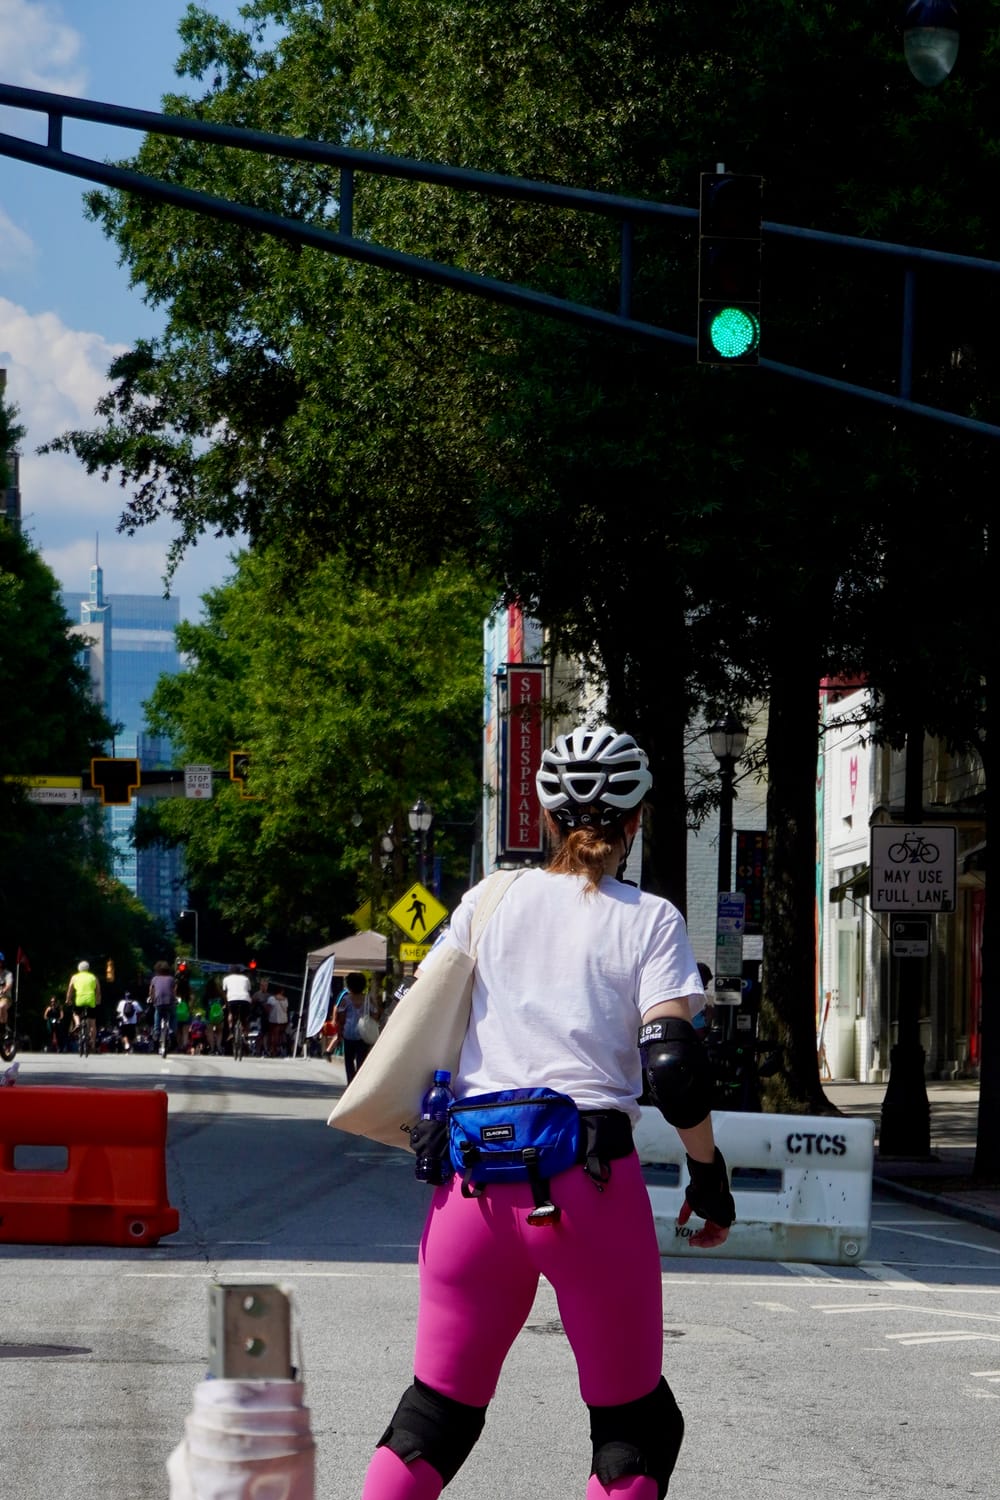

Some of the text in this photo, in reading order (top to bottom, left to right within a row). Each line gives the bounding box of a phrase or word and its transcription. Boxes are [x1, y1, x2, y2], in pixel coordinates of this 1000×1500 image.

[519, 677, 532, 843] SHAKESPEARE
[188, 775, 209, 783] STOP
[884, 869, 943, 884] MAY USE
[877, 889, 949, 903] FULL LANE
[404, 948, 427, 958] AHEA
[786, 1132, 847, 1156] CTCS
